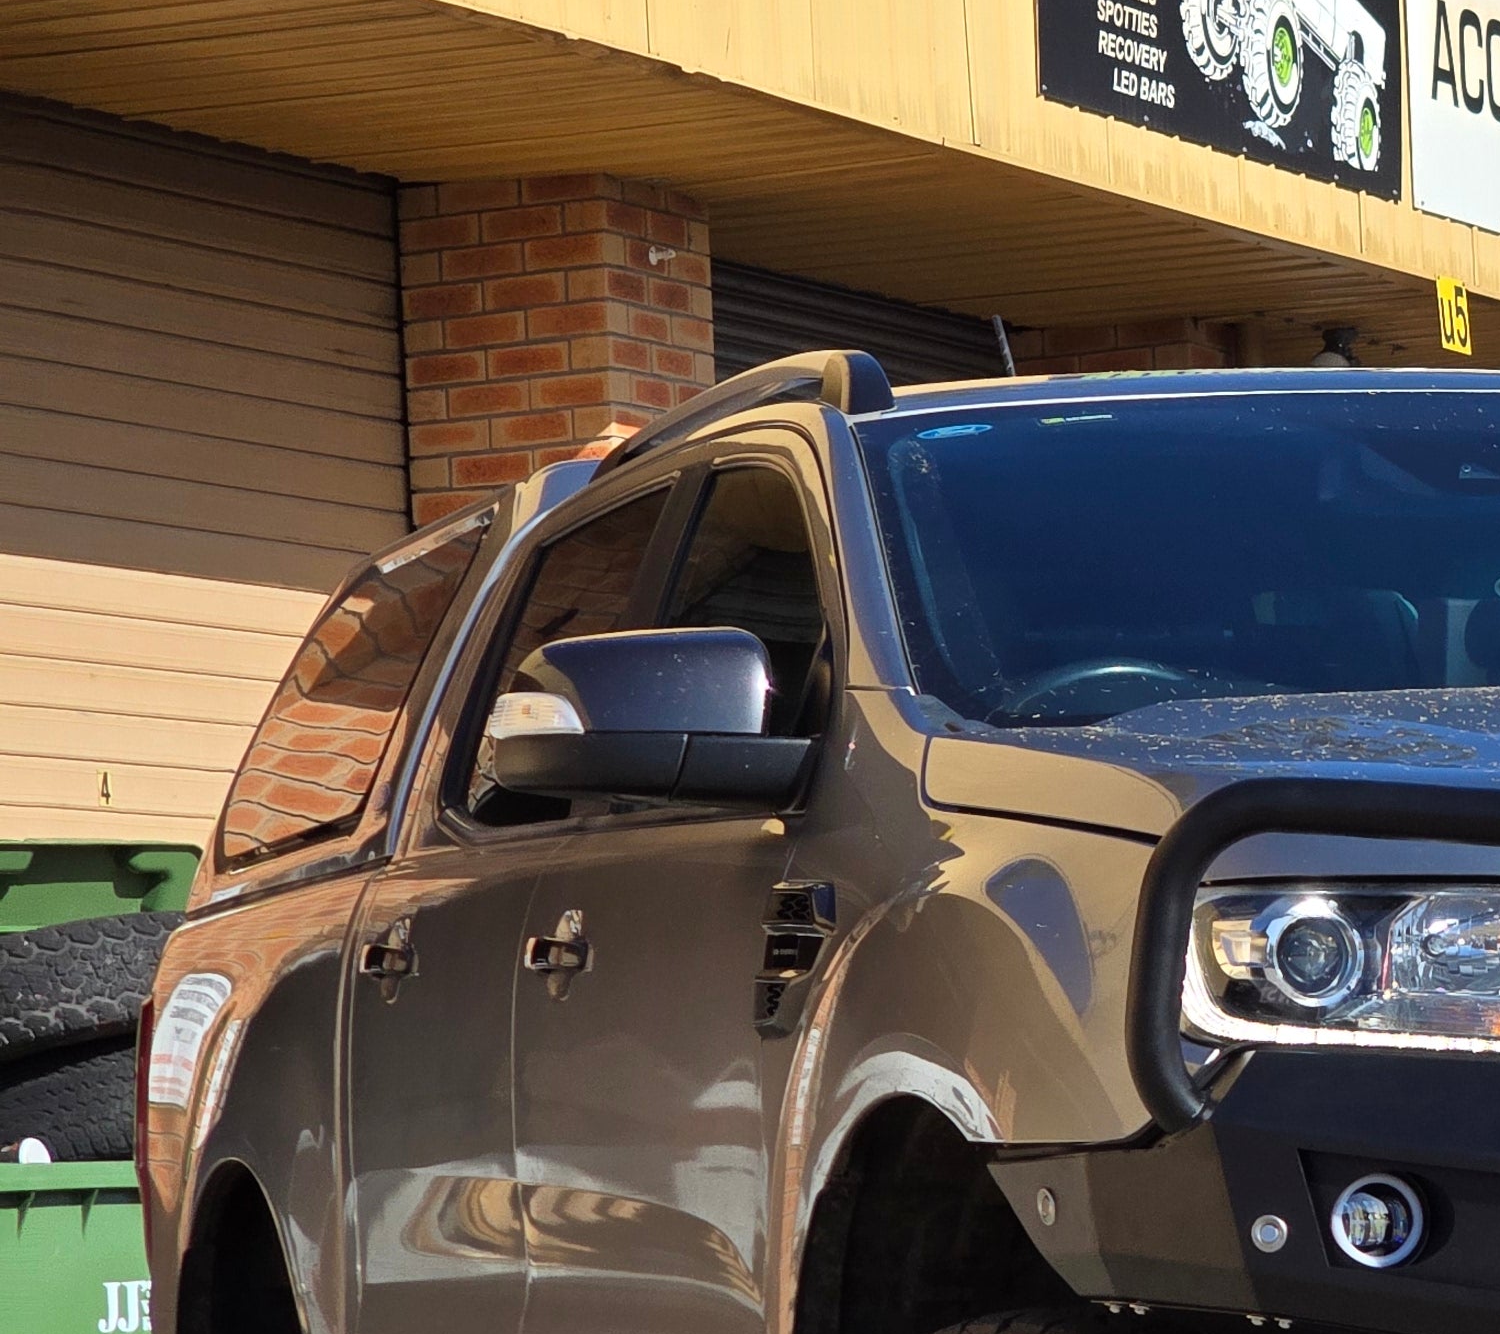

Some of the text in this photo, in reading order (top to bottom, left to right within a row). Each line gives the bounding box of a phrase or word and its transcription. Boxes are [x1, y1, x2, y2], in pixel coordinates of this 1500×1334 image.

[1098, 29, 1168, 73] RECOVERY
[1112, 67, 1176, 109] LED BARS
[101, 771, 111, 805] 4
